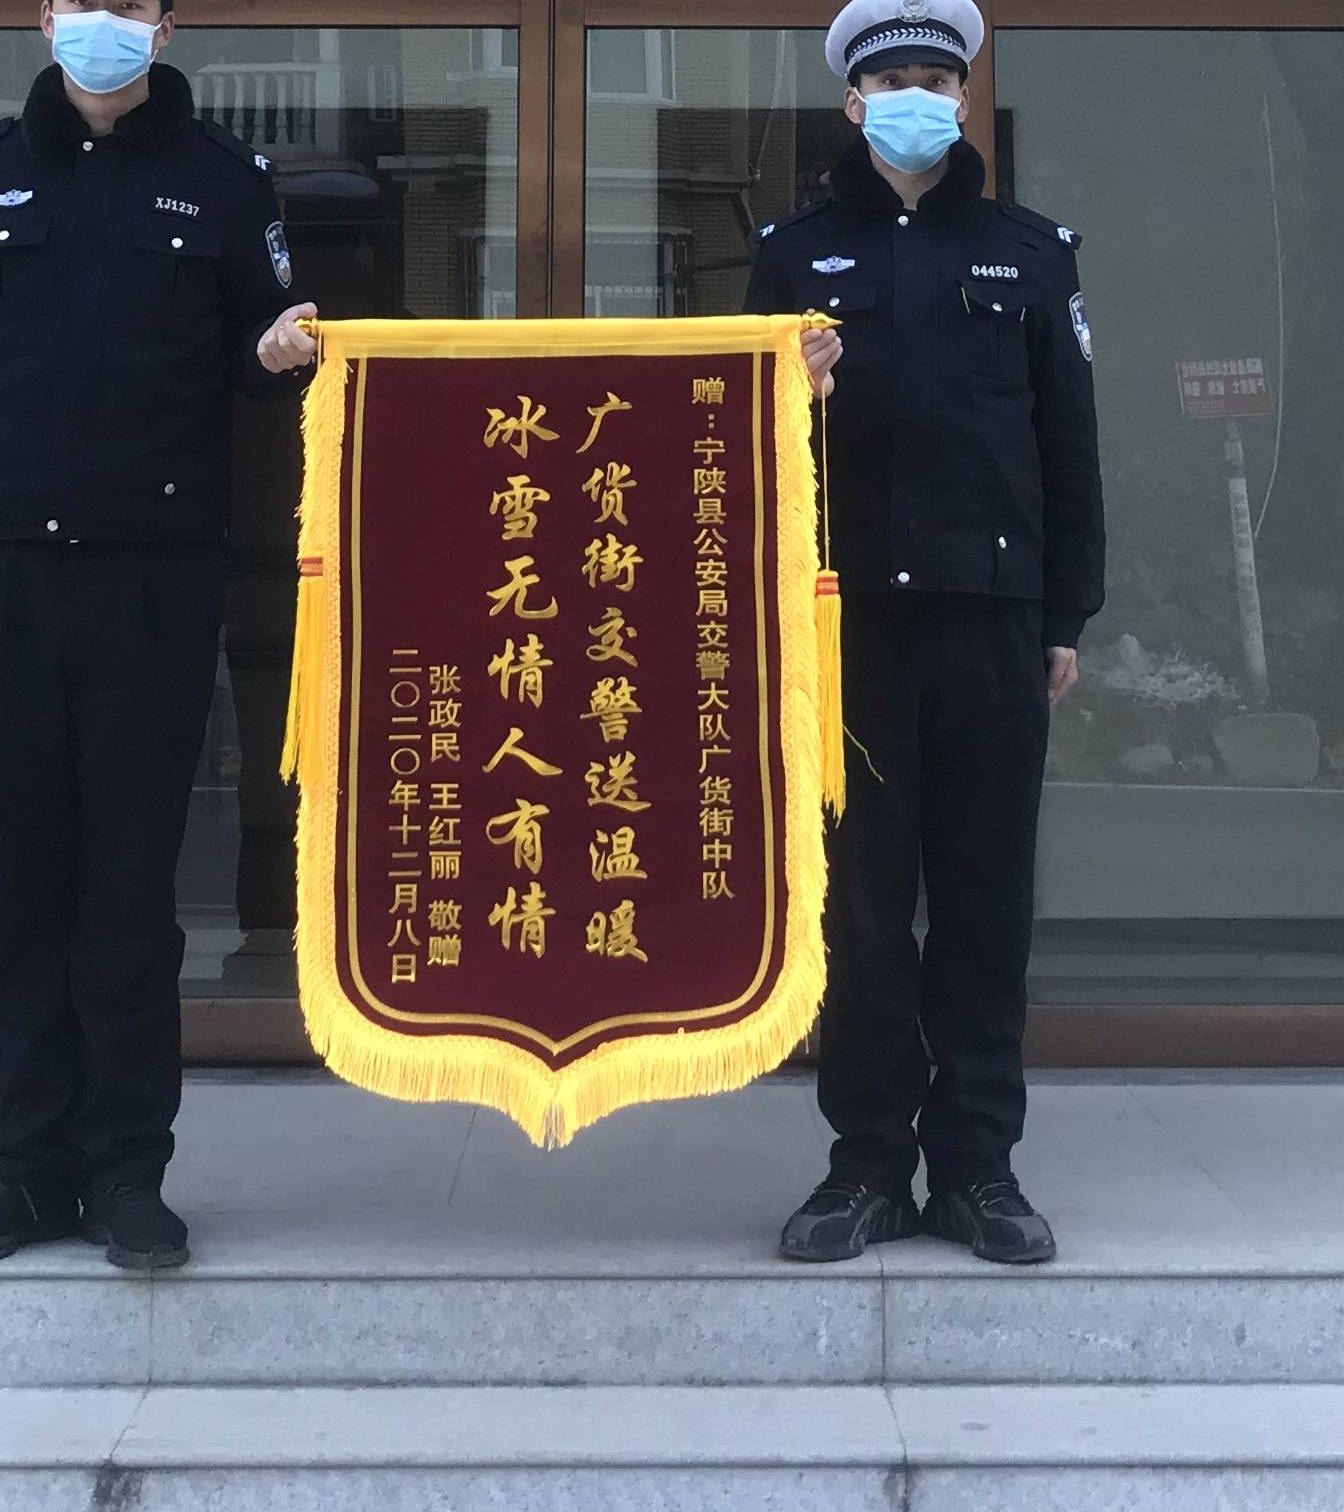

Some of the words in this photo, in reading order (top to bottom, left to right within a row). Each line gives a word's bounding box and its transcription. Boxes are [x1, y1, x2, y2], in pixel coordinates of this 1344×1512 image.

[155, 196, 200, 217] XJ1237
[971, 264, 1019, 279] 044520
[428, 663, 462, 763] 张政民
[481, 395, 564, 960] 冰雪无情人有情
[576, 391, 652, 963] 广货街交警送温暖
[428, 782, 462, 880] 王红丽
[427, 899, 462, 967] 敬赠
